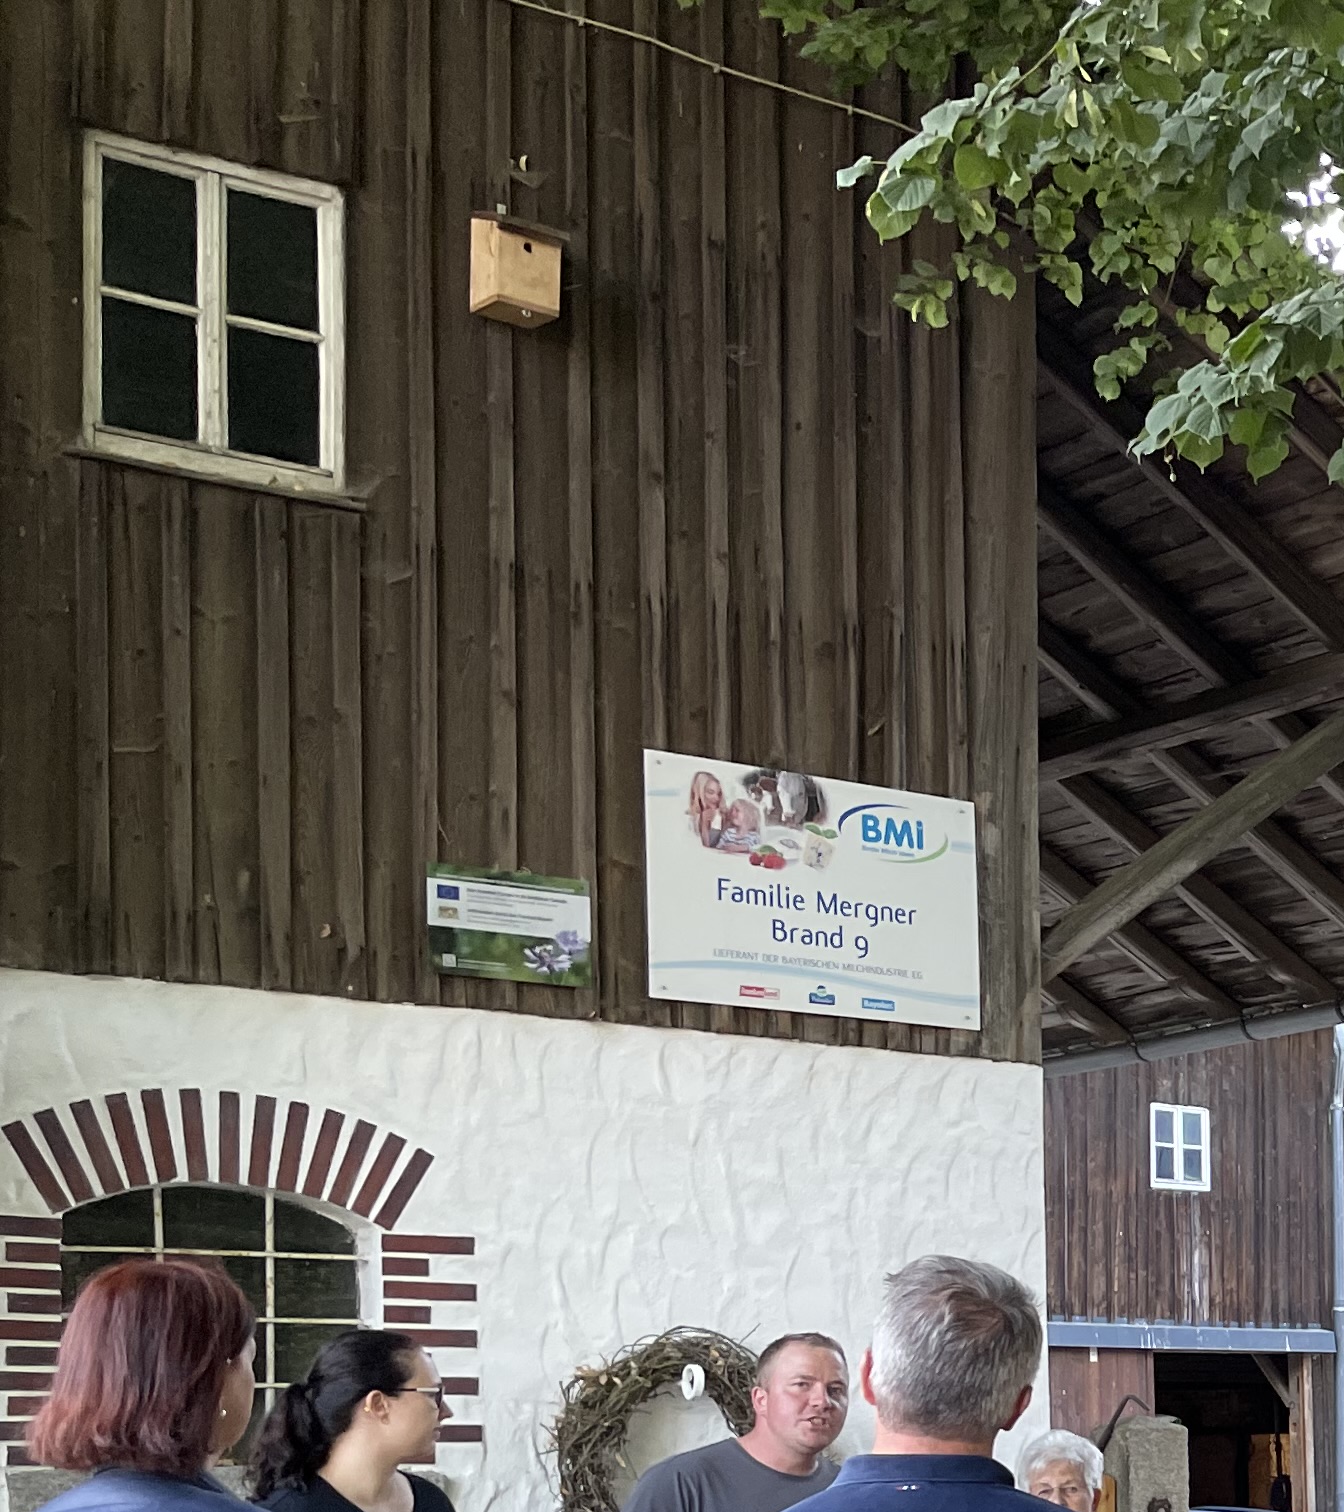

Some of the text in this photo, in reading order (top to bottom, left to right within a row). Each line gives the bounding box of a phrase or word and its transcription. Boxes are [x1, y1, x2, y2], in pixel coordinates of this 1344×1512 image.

[717, 877, 917, 927] Familie Mergner
[713, 948, 760, 961] LIEFERANT
[761, 953, 780, 963] DER
[781, 955, 840, 970] BAYERISCHEN
[771, 918, 870, 959] Brand 9
